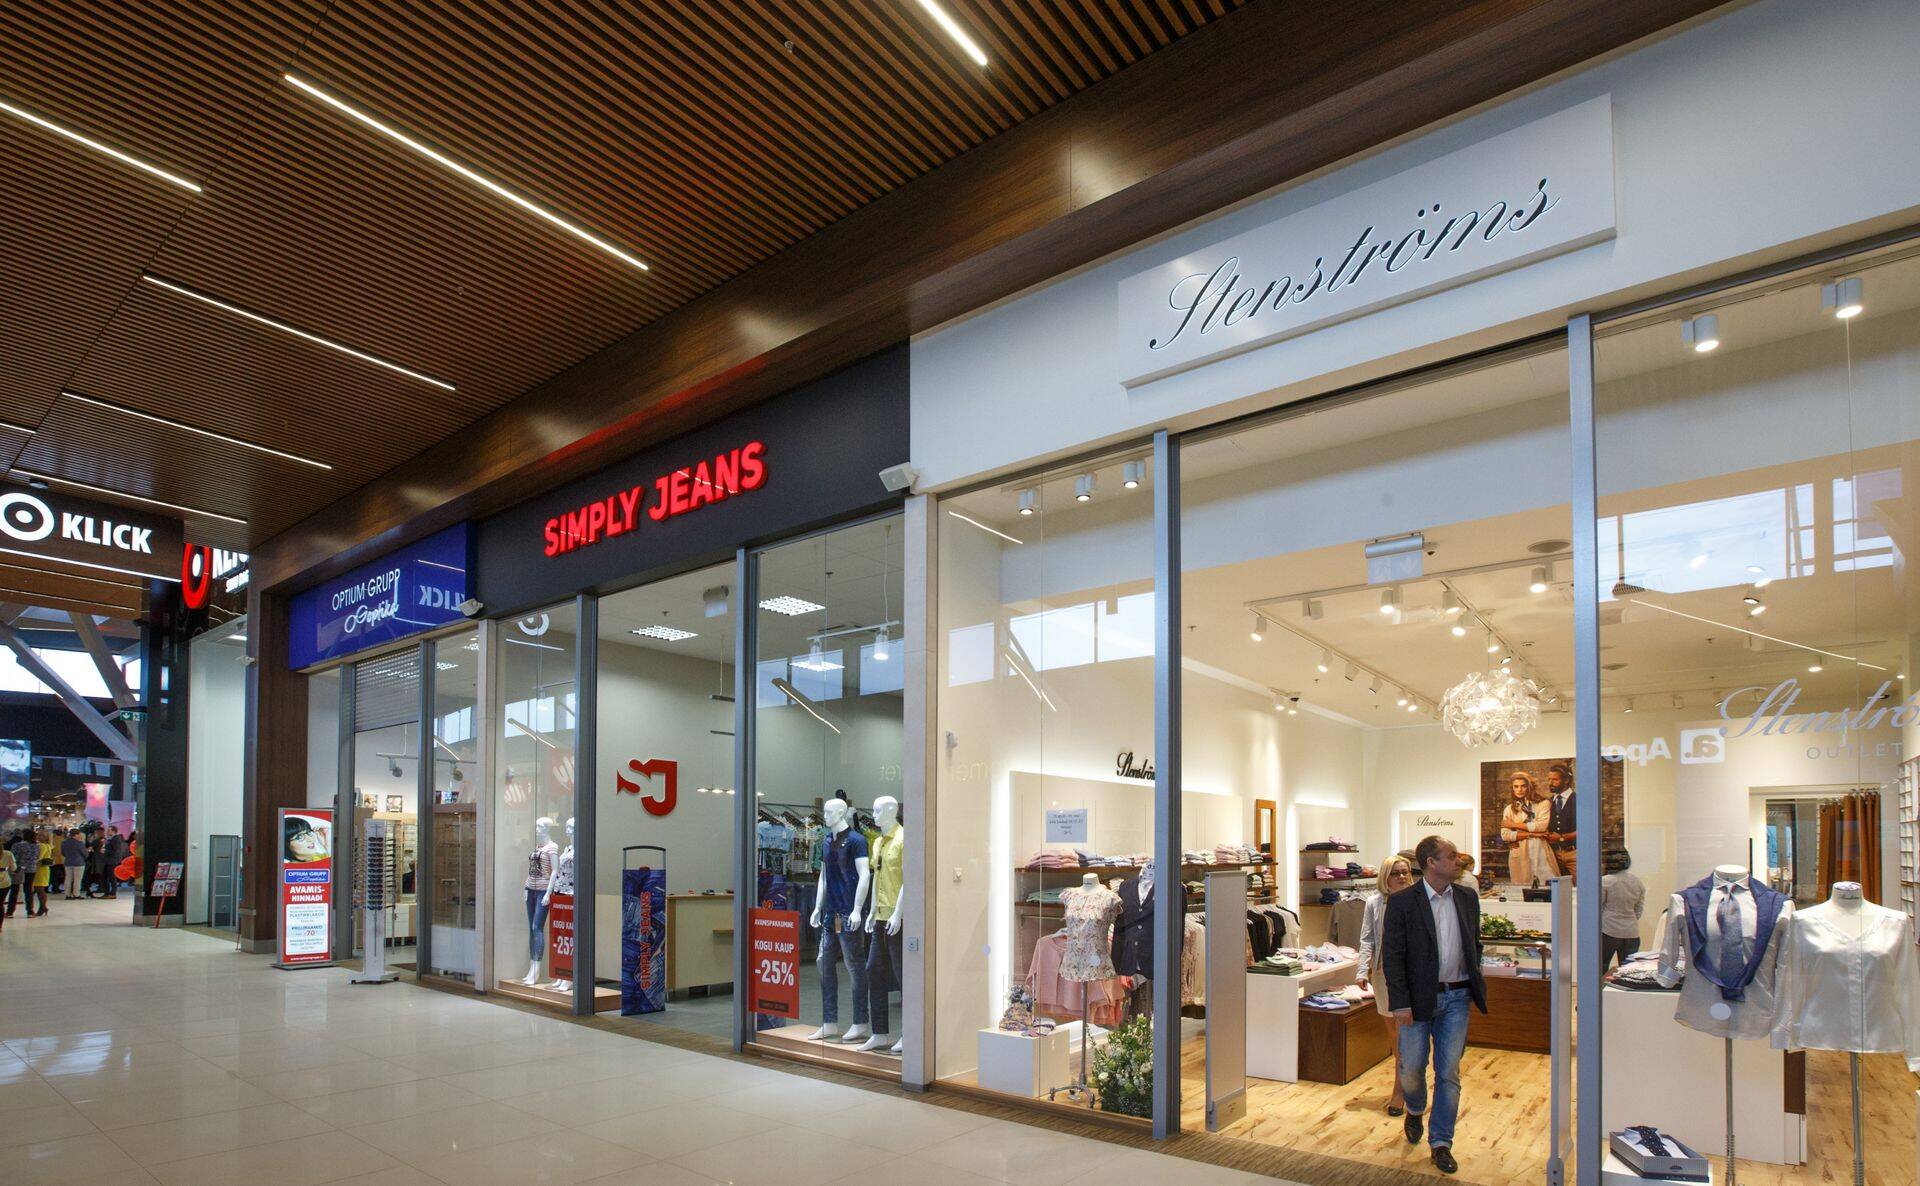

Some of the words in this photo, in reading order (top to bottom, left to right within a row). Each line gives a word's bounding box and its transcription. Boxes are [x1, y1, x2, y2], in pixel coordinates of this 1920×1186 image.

[1149, 176, 1561, 351] Stenströms
[544, 486, 645, 558] SIMPLY
[649, 440, 769, 523] JEANS
[62, 512, 153, 554] KLICK
[1806, 742, 1902, 760] OUTLET
[289, 885, 326, 894] AVAMIS-
[640, 891, 652, 936] JEANS
[640, 941, 652, 990] SIMPLY
[754, 939, 773, 952] KOGU
[774, 941, 795, 954] KAUP
[754, 959, 795, 987] -25%
